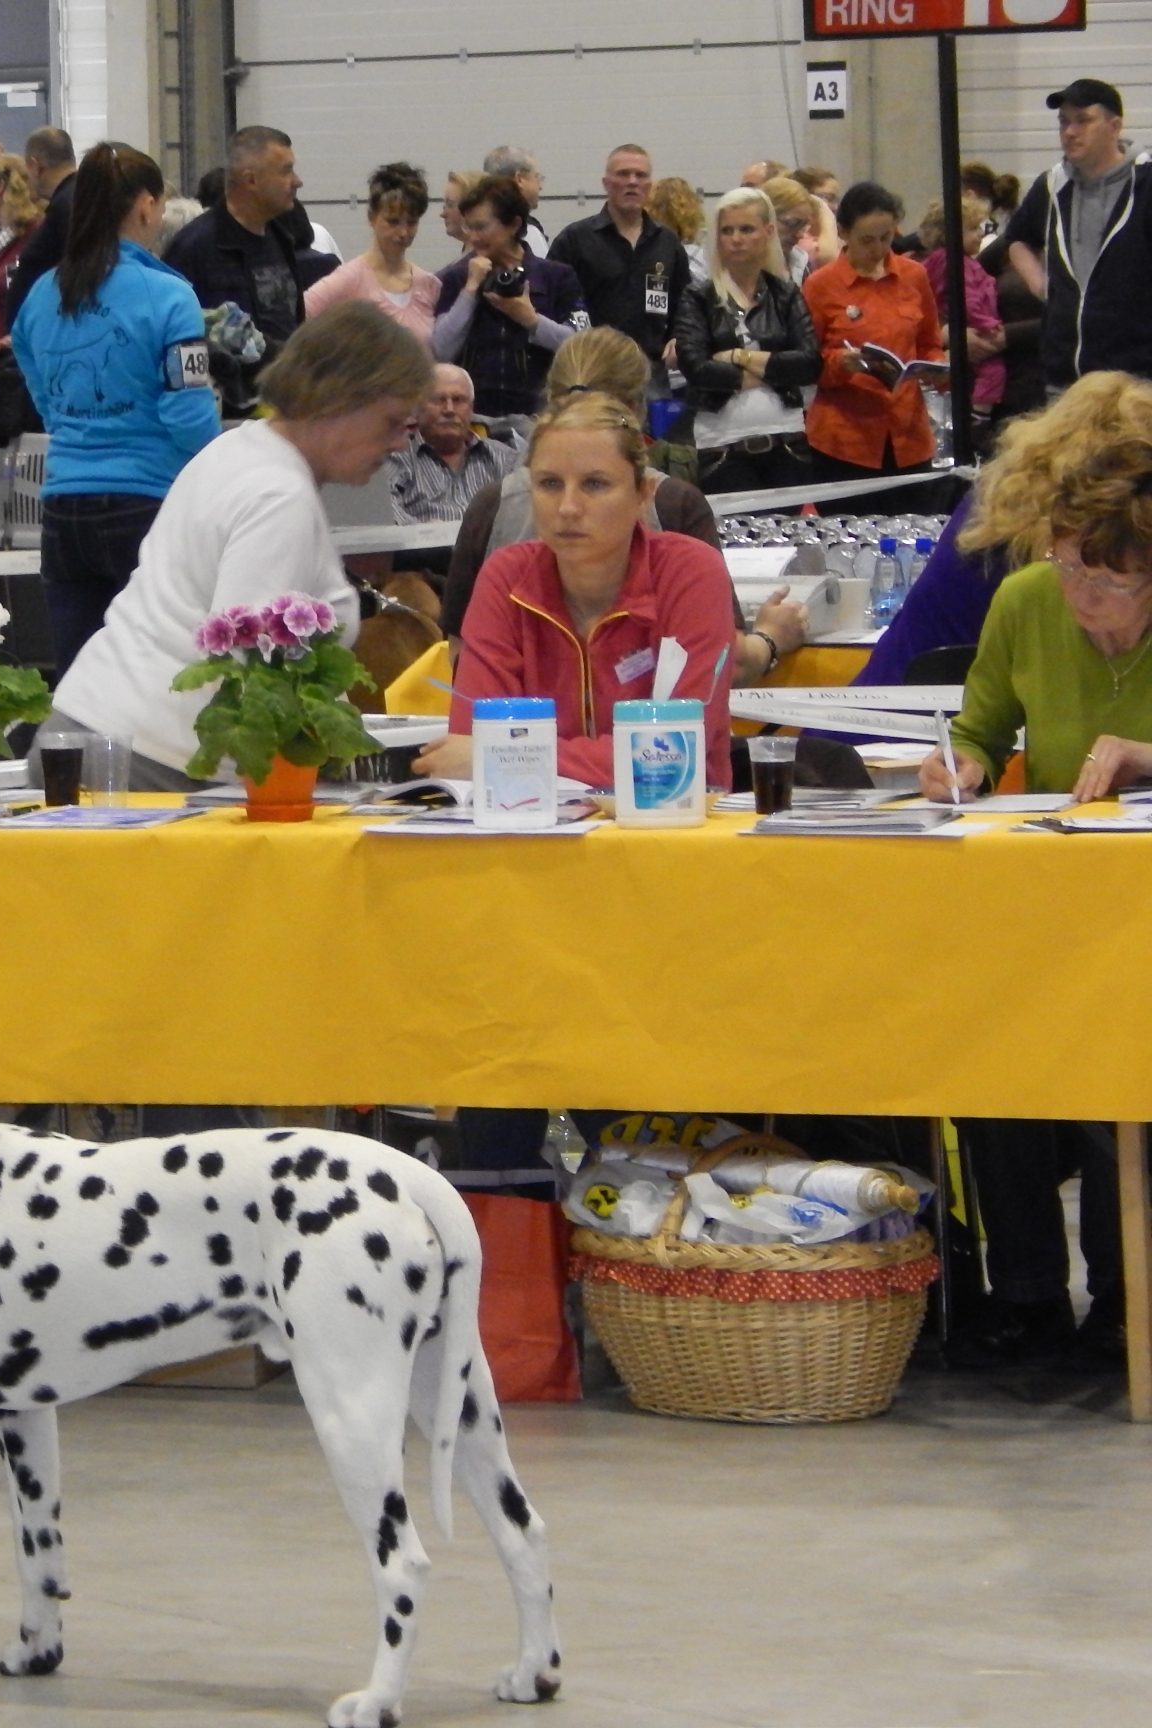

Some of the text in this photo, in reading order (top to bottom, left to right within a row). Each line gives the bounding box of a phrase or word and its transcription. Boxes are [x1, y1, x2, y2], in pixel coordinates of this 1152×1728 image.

[824, 0, 915, 26] RING
[813, 81, 839, 101] A3
[647, 294, 667, 309] 483
